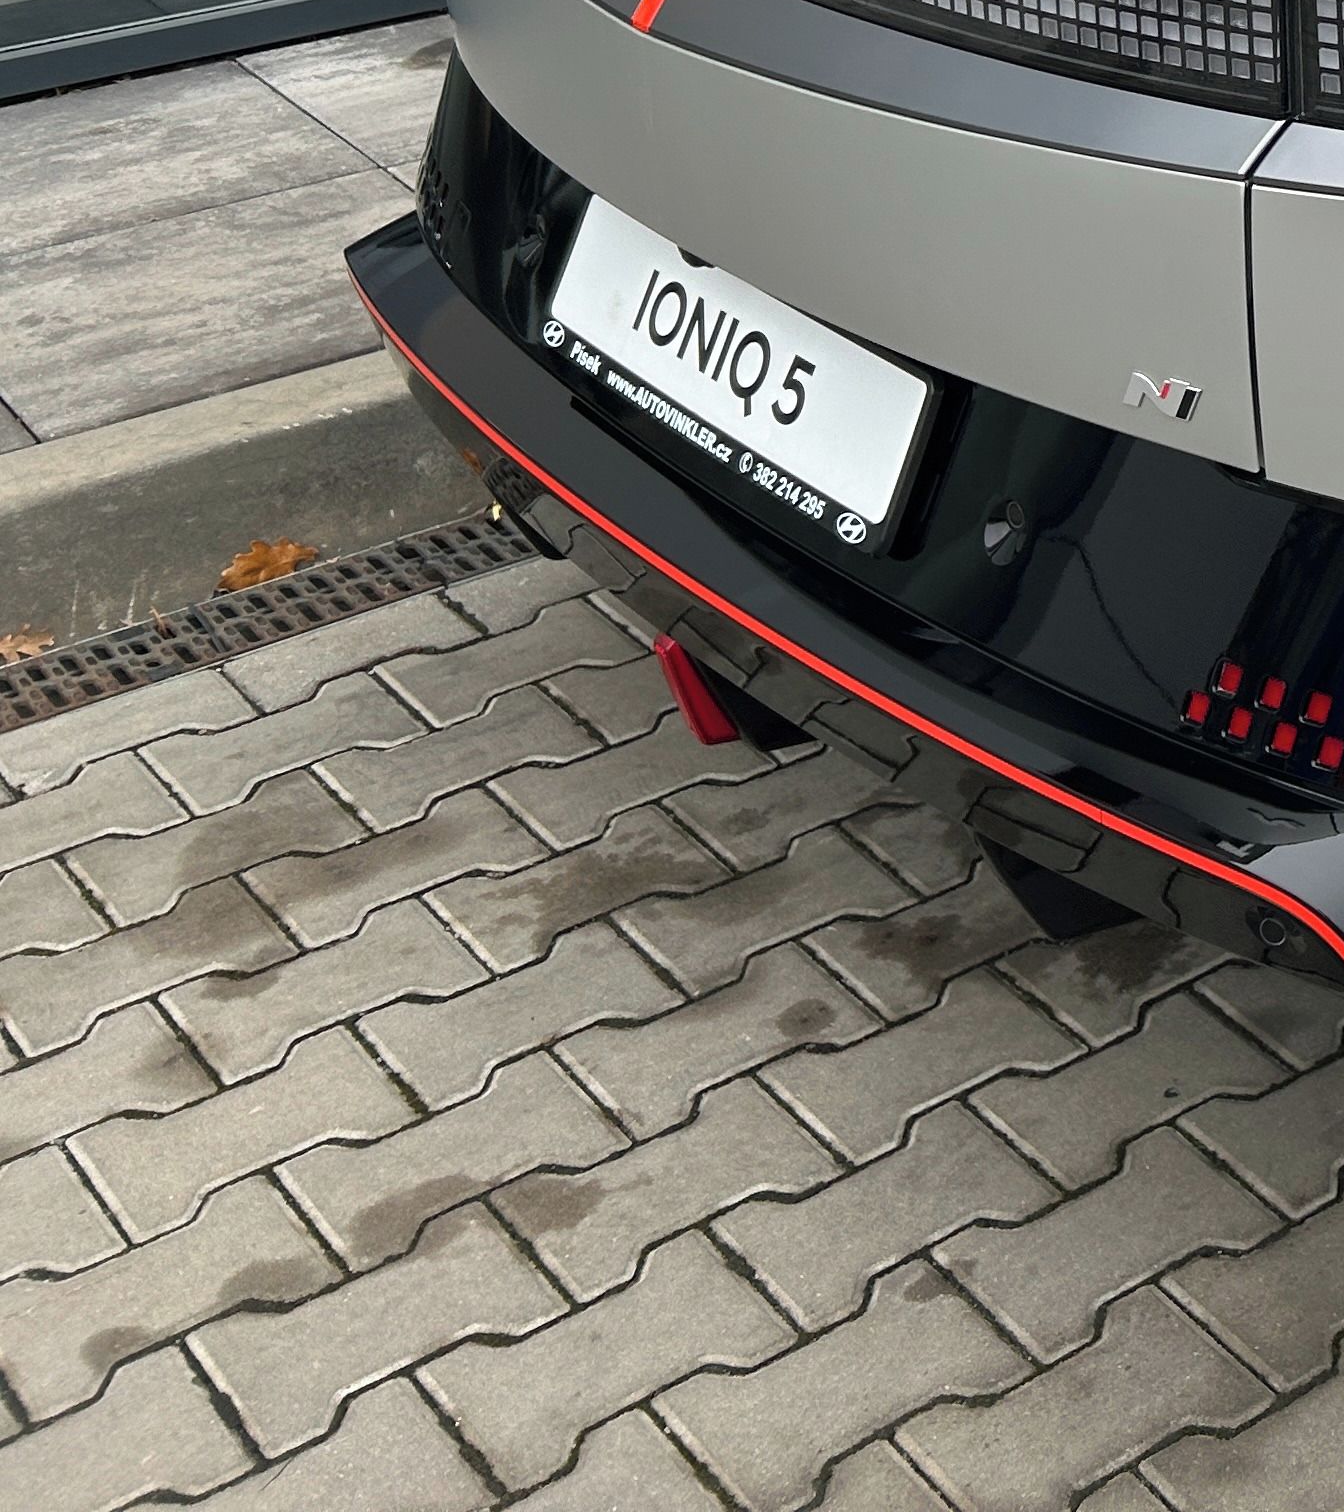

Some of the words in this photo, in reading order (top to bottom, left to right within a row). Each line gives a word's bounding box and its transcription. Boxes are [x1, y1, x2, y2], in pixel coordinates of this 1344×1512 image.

[569, 340, 602, 376] Písek
[606, 369, 733, 464] www.AUTOVINKLER.cz
[752, 462, 778, 491] 382
[776, 476, 802, 506] 214
[798, 490, 827, 520] 295
[631, 268, 772, 419] IONIQ
[770, 353, 817, 426] 5
